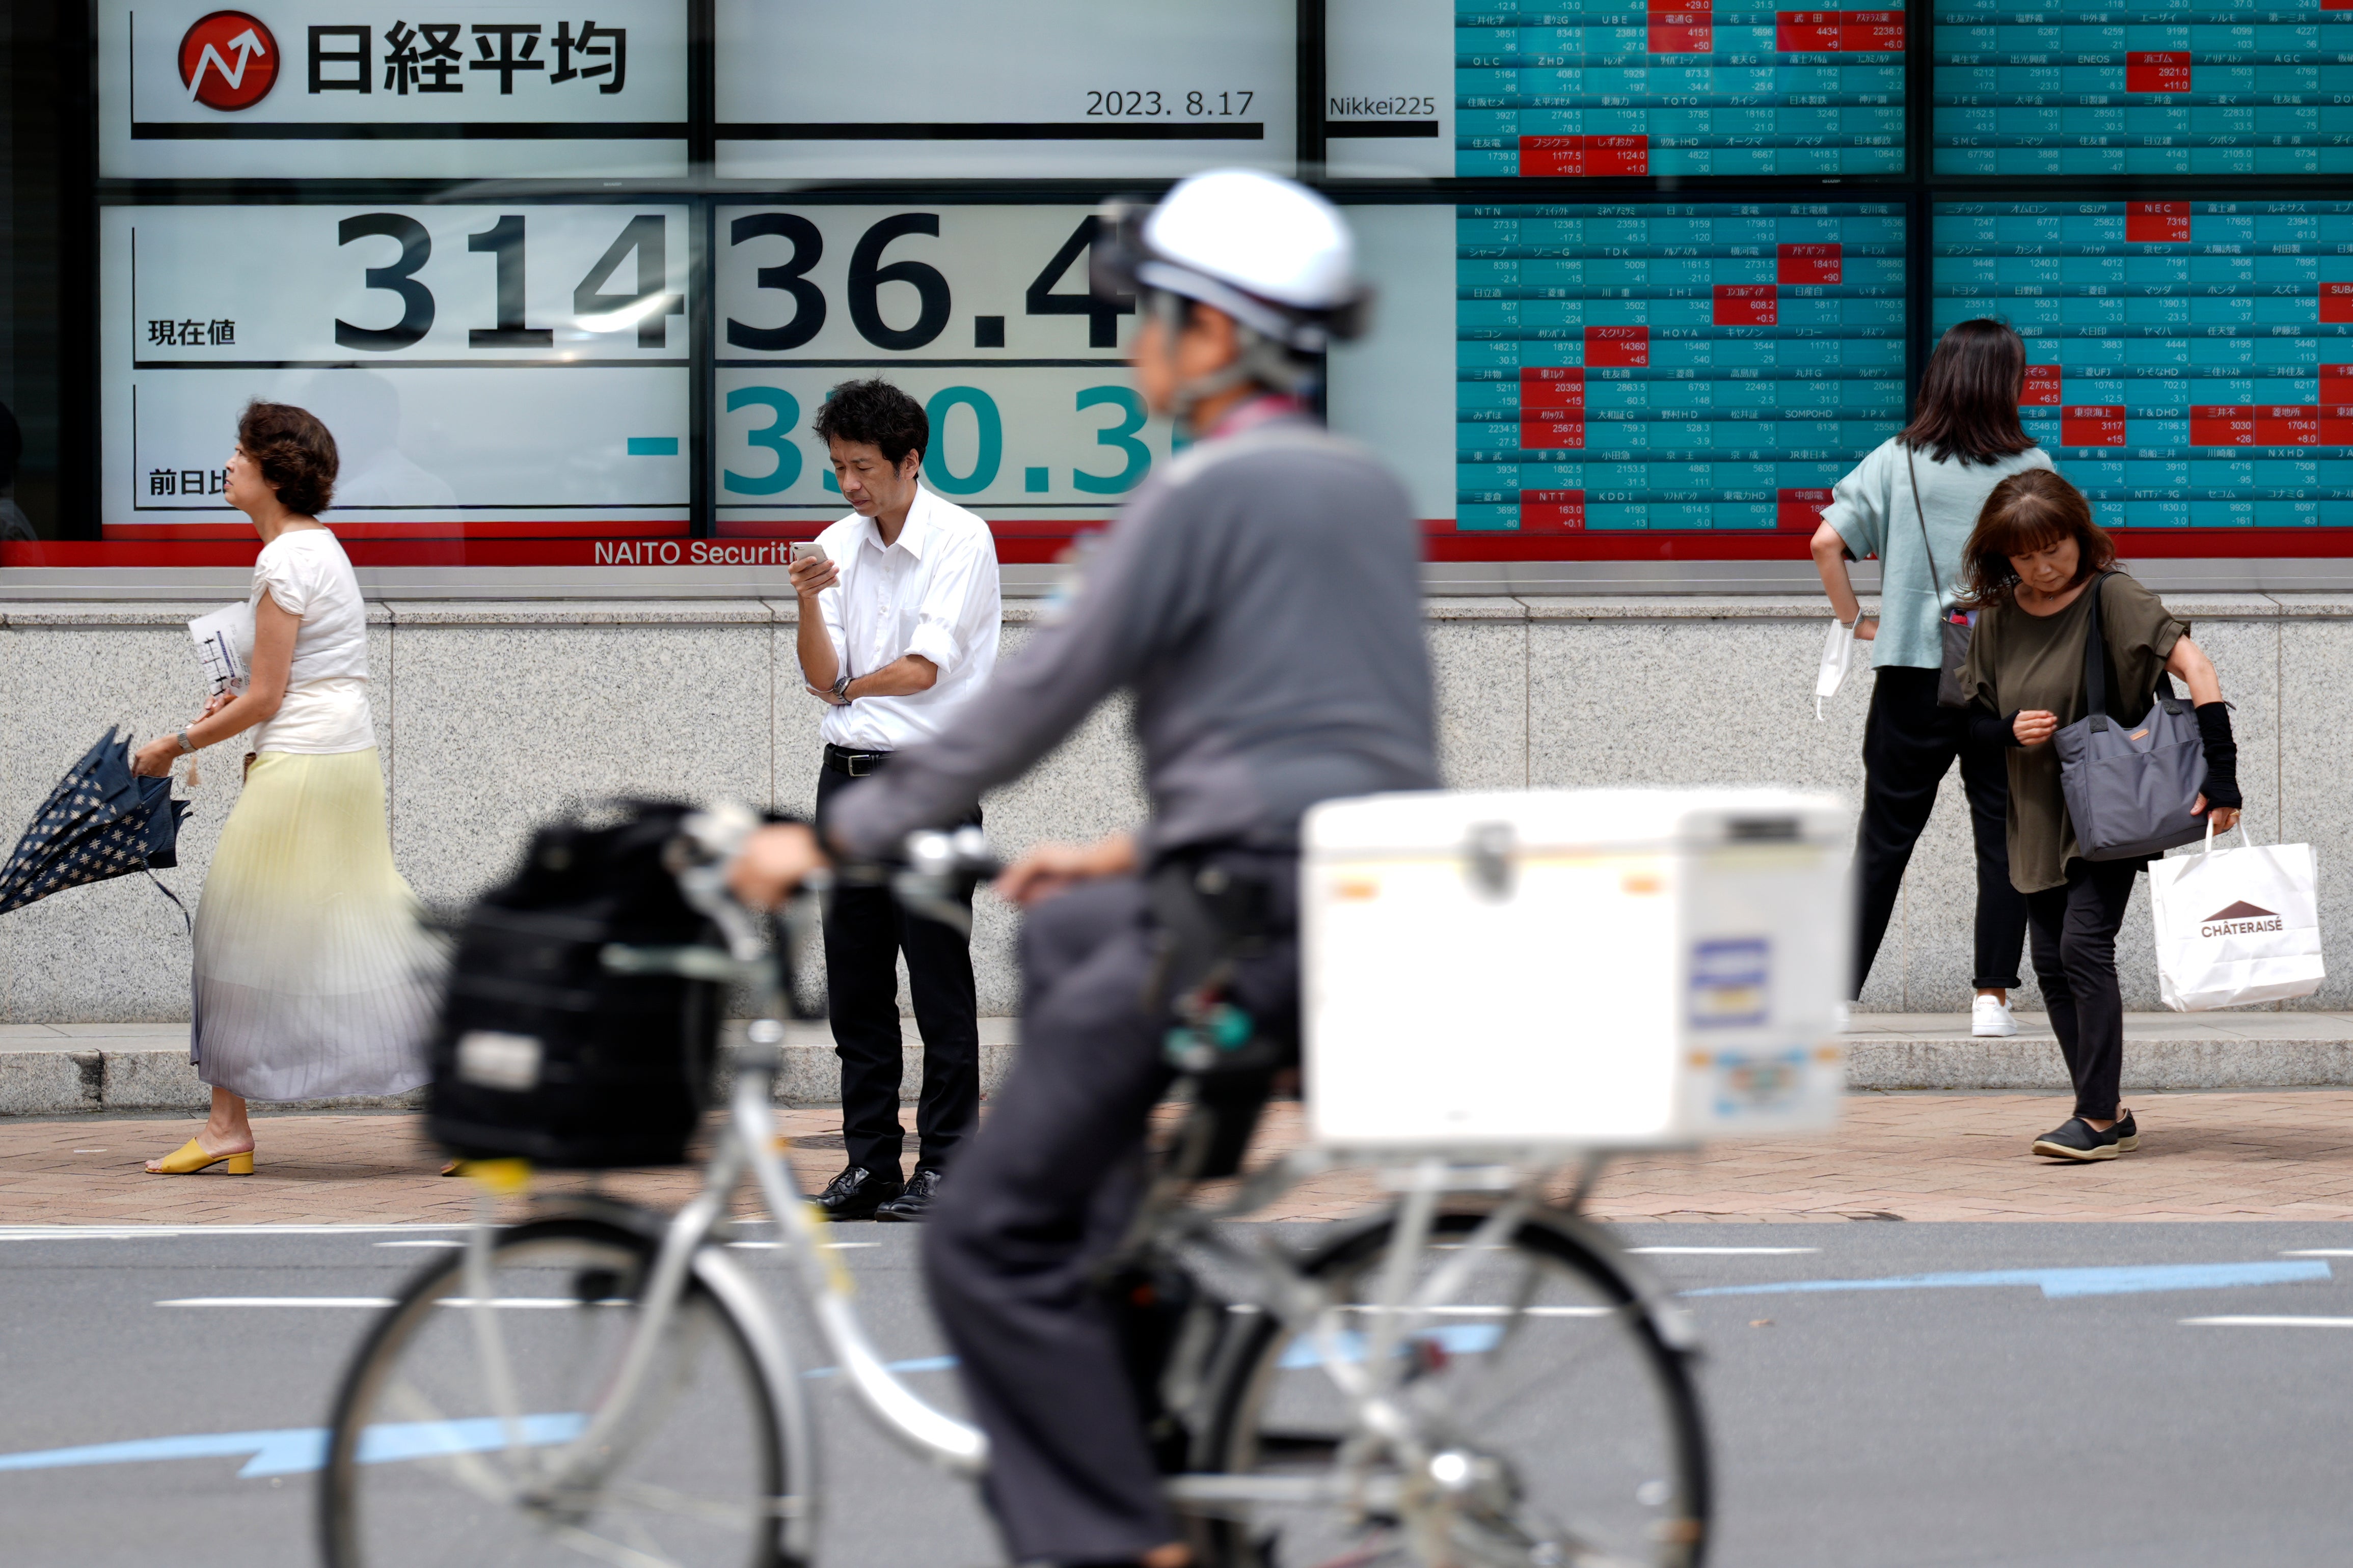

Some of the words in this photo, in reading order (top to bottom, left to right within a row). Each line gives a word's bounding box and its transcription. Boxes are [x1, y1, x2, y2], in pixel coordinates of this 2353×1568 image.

[1873, 27, 1902, 35] 2238.0
[2296, 27, 2316, 35] 4227
[1693, 42, 1709, 50] +50
[308, 20, 626, 95] 日経平均
[1557, 69, 1580, 78] 408.0
[2159, 68, 2187, 76] 2921.0
[1331, 97, 1435, 115] Nikkei225
[1496, 112, 1516, 120] 3927
[1552, 111, 1580, 119] 2740.5
[1553, 152, 1581, 160] 1177.5
[1617, 151, 1644, 159] 1124.0
[1627, 164, 1645, 173] +1.0
[2167, 217, 2187, 226] 7316
[2171, 231, 2187, 239] +16
[1823, 273, 1838, 282] +90
[1751, 301, 1774, 309] 608.2
[1756, 314, 1774, 322] +0.5
[148, 319, 235, 346] 現在値
[1620, 342, 1645, 350] 14360
[1630, 355, 1645, 364] +45
[1555, 383, 1581, 392] 20390
[2294, 380, 2315, 389] 6217
[1565, 397, 1581, 405] +15
[1489, 425, 1517, 433] 2234.5
[1553, 424, 1581, 432] 2567.0
[2101, 422, 2123, 430] 3117
[2158, 422, 2186, 430] 2196.5
[2230, 421, 2251, 429] 3030
[2288, 421, 2316, 429] 1704.0
[1563, 437, 1581, 446] +5.0
[2235, 435, 2251, 443] +26
[1559, 506, 1582, 514] 163.0
[1562, 519, 1580, 527] +0.1
[595, 541, 681, 564] NAITO
[2201, 916, 2283, 938] CHÂTERAISÉ
